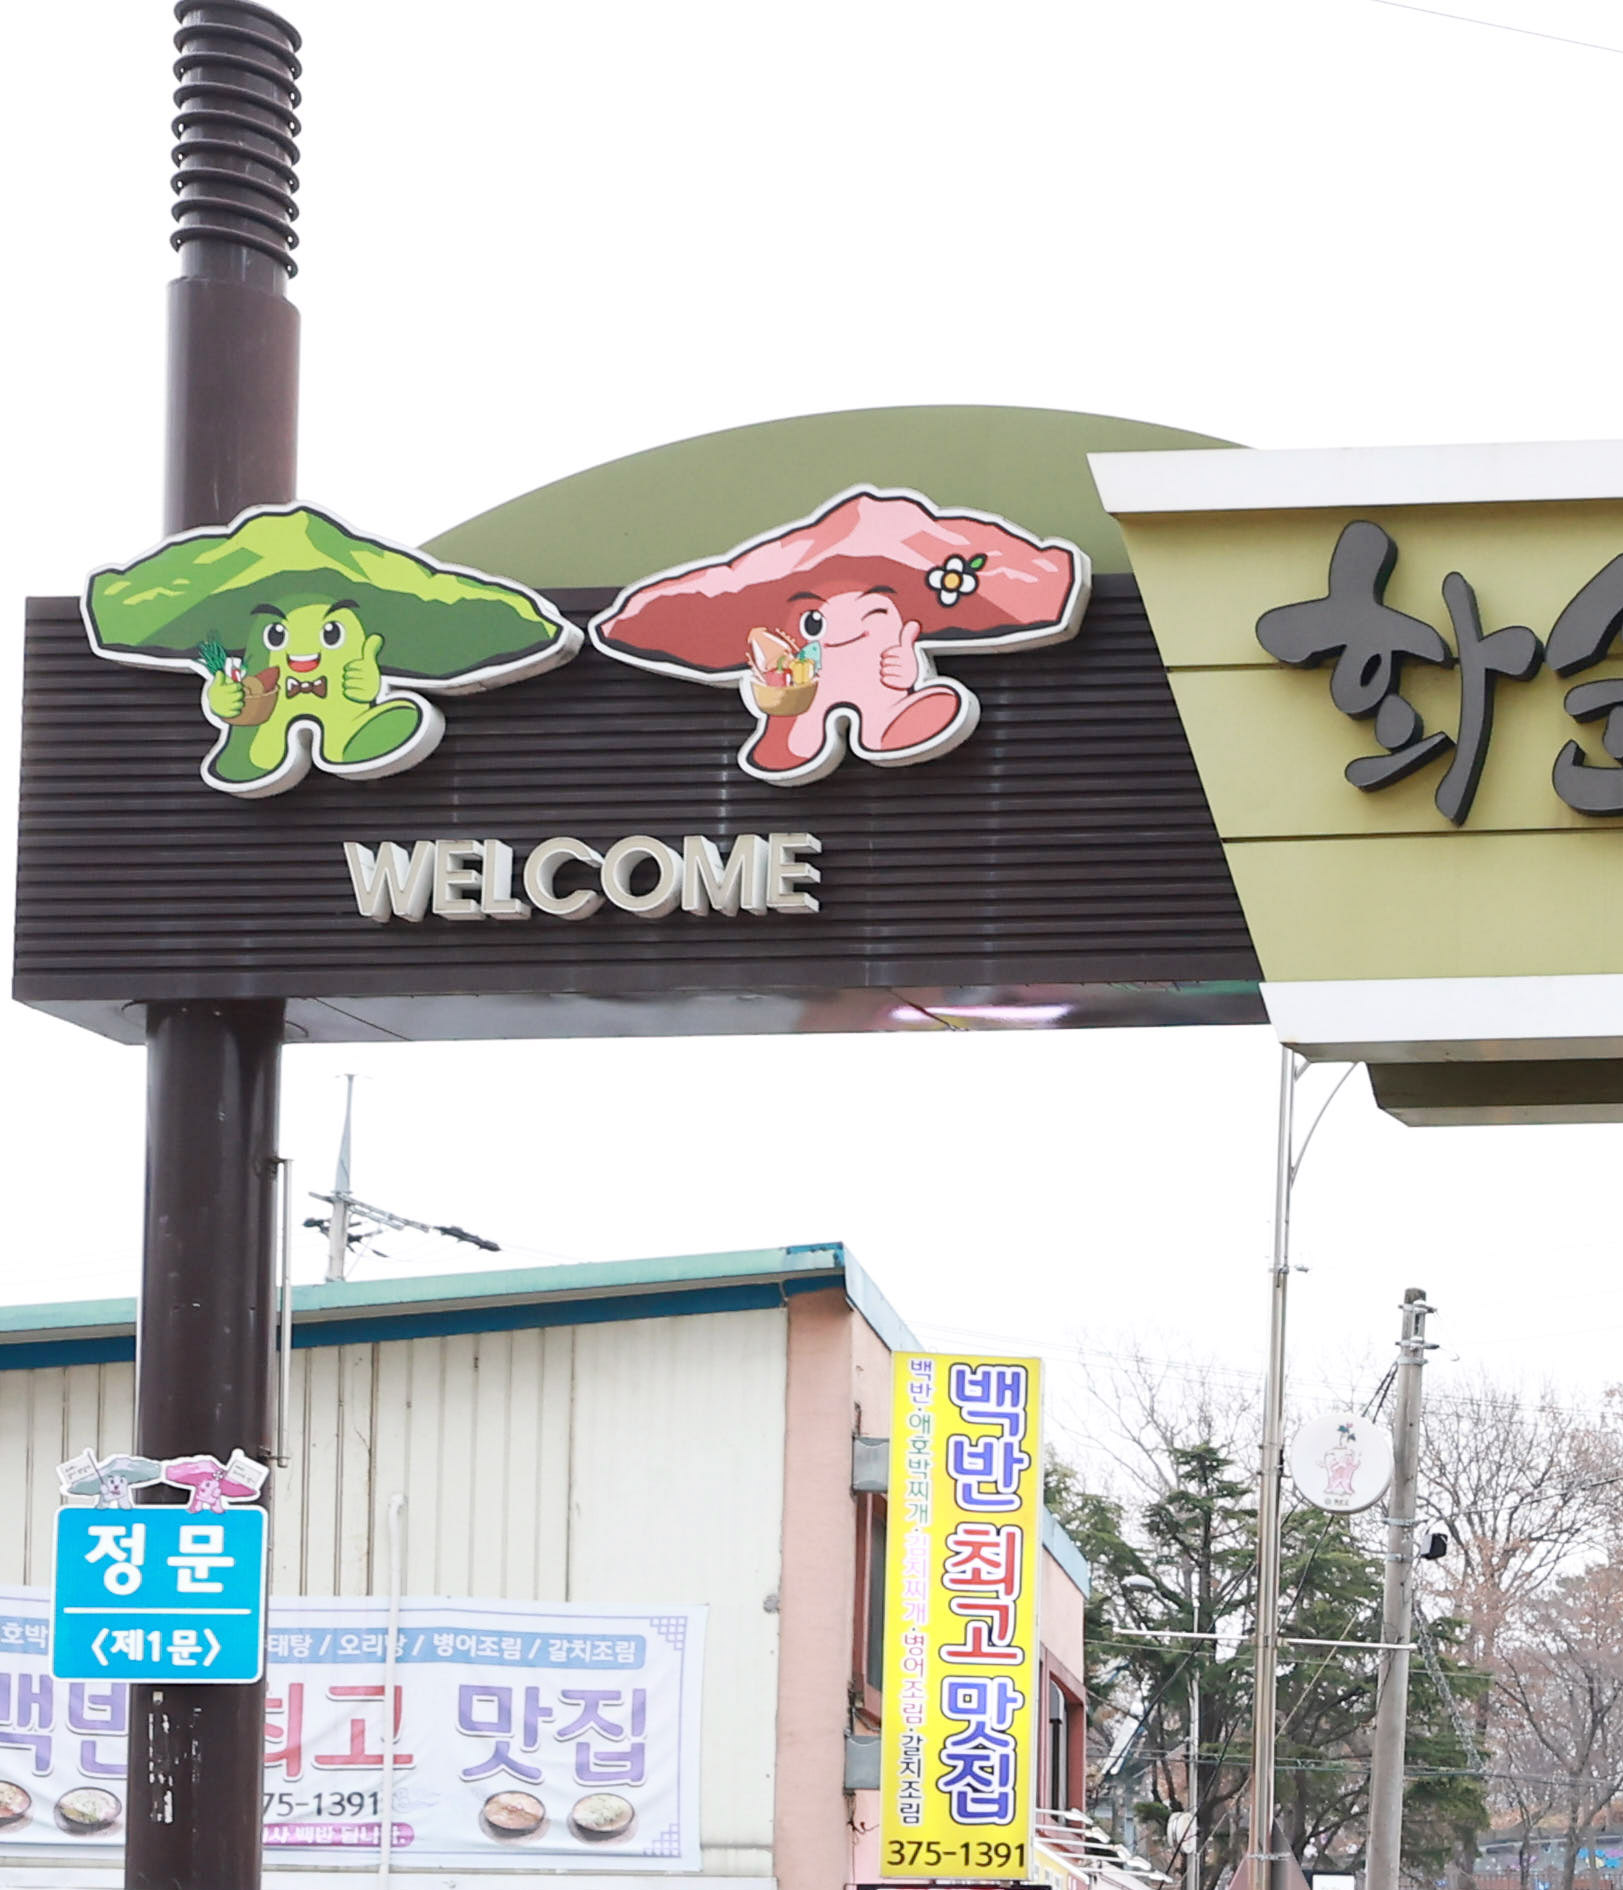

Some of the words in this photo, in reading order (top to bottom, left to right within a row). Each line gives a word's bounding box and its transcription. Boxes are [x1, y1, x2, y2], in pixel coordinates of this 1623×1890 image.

[345, 832, 822, 923] WELCOME
[948, 1362, 1032, 1512] 백반
[938, 1521, 1026, 1666] 최고
[433, 1633, 522, 1661] 병어조림
[548, 1639, 637, 1664] 갈치조림
[457, 1683, 647, 1784] 맛집
[935, 1673, 1026, 1826] 맛집
[887, 1841, 1026, 1869] 375-1391
